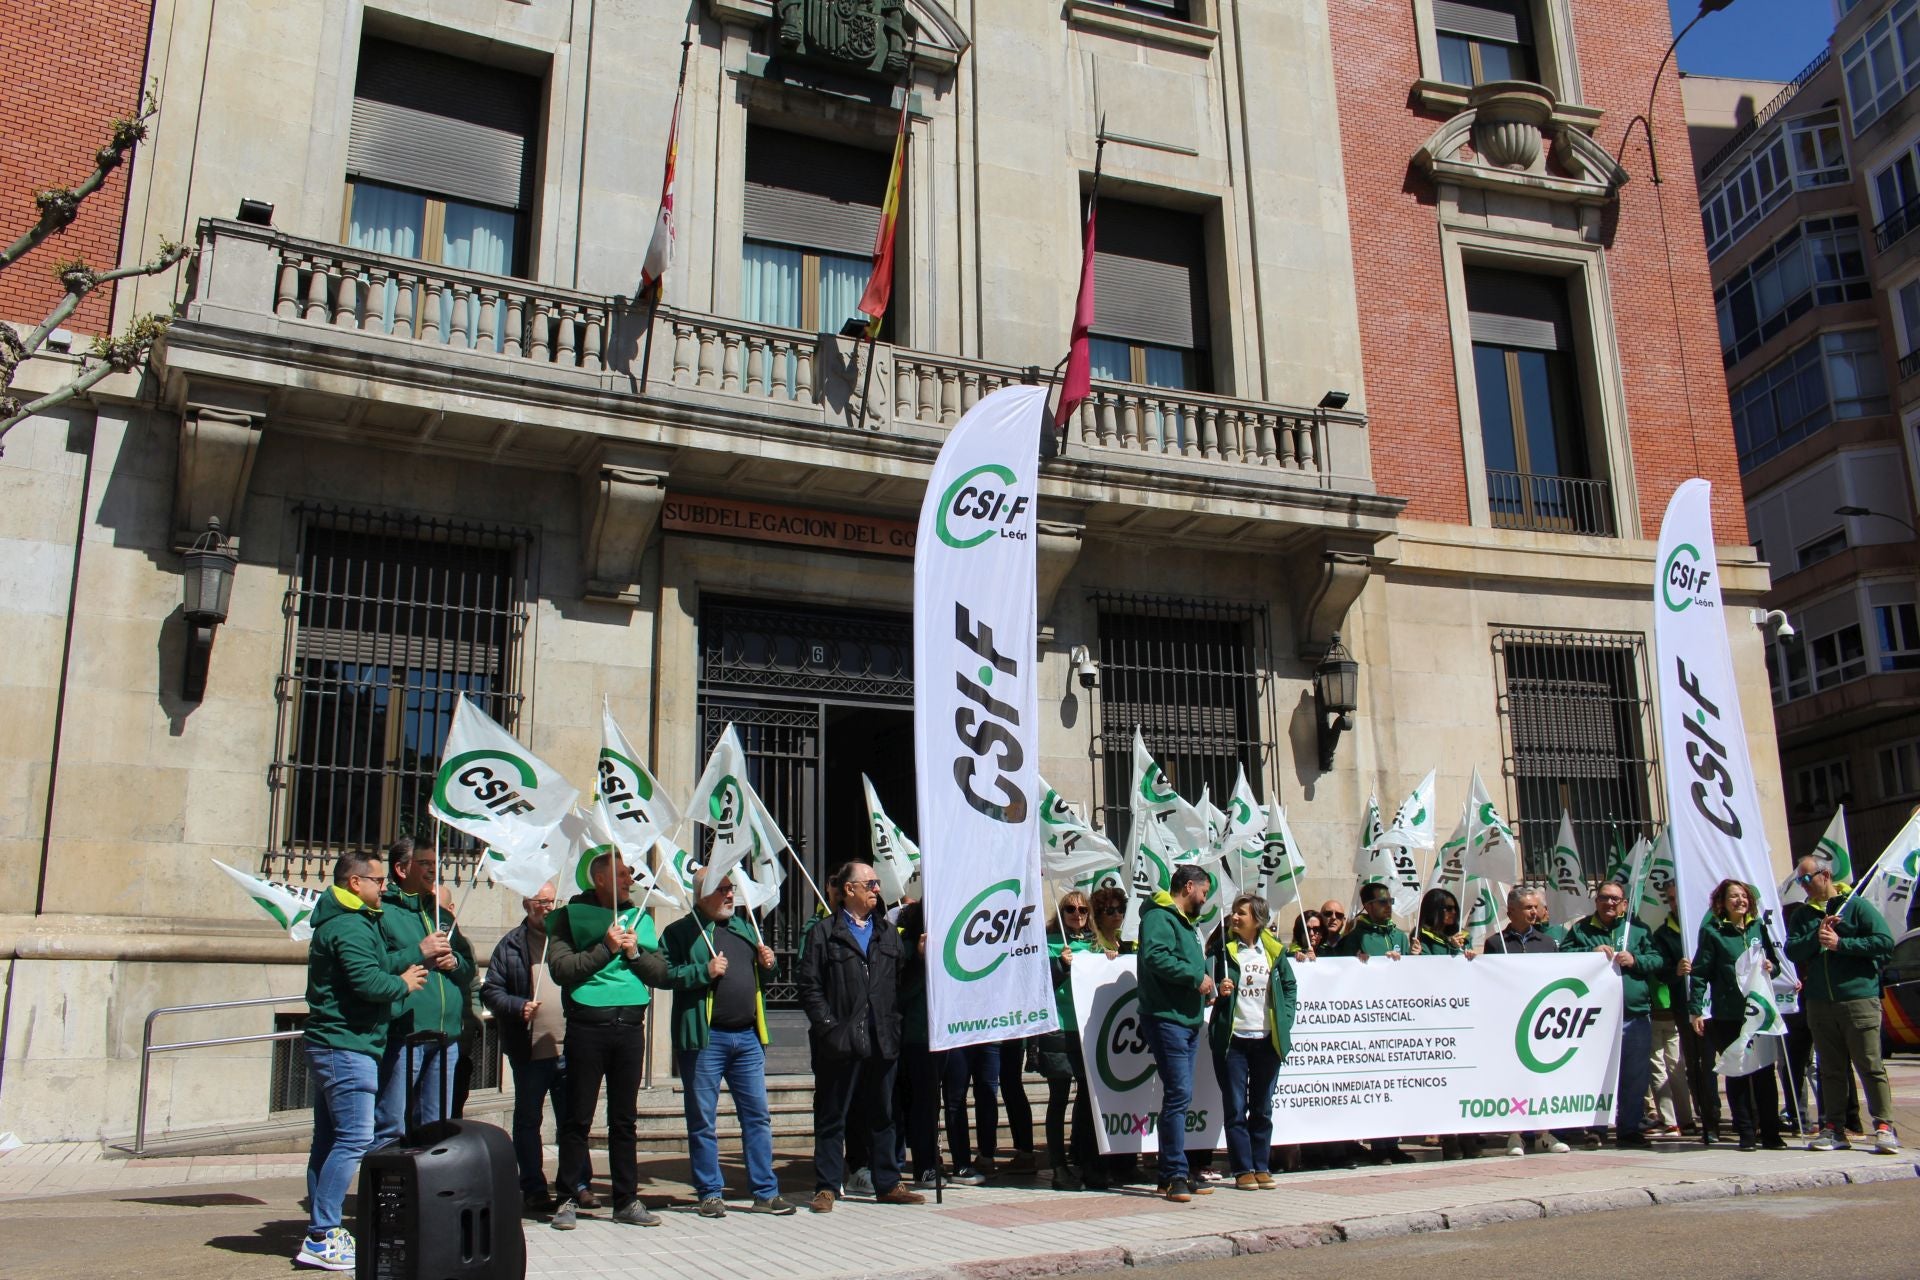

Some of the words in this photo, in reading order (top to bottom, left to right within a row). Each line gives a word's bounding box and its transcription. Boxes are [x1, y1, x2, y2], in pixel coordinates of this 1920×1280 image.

[664, 502, 837, 539] SUBDELEGACION
[843, 523, 883, 545] DEL
[1000, 528, 1028, 541] León
[1694, 596, 1714, 608] León
[814, 647, 823, 662] 6
[458, 766, 536, 817] CSIF
[1010, 944, 1039, 957] León
[1238, 988, 1265, 998] OAST
[1304, 1001, 1328, 1012] PARA
[1329, 1000, 1363, 1010] TODAS
[1366, 999, 1384, 1010] LAS
[1386, 995, 1447, 1009] CATEGORÍAS
[1449, 997, 1470, 1008] QUE
[948, 1008, 1049, 1034] www.csif.es
[1296, 1015, 1307, 1025] LA
[1308, 1013, 1351, 1024] CALIDAD
[1353, 1011, 1416, 1023] ASISTENCIAL.
[1534, 1007, 1602, 1040] CSIF
[1369, 1037, 1424, 1050] ANTICIPADA
[1425, 1037, 1432, 1047] Y
[1435, 1036, 1457, 1048] POR
[1308, 1054, 1335, 1065] PARA
[1337, 1053, 1385, 1064] PERSONAL
[1388, 1050, 1456, 1063] ESTATUTARIO.
[1332, 1080, 1382, 1092] INMEDIATA
[1384, 1078, 1395, 1089] DE
[1397, 1076, 1448, 1089] TÉCNICOS
[1281, 1097, 1288, 1108] Y
[1290, 1094, 1349, 1108] SUPERIORES
[1350, 1093, 1362, 1104] AL
[1375, 1091, 1382, 1102] Y
